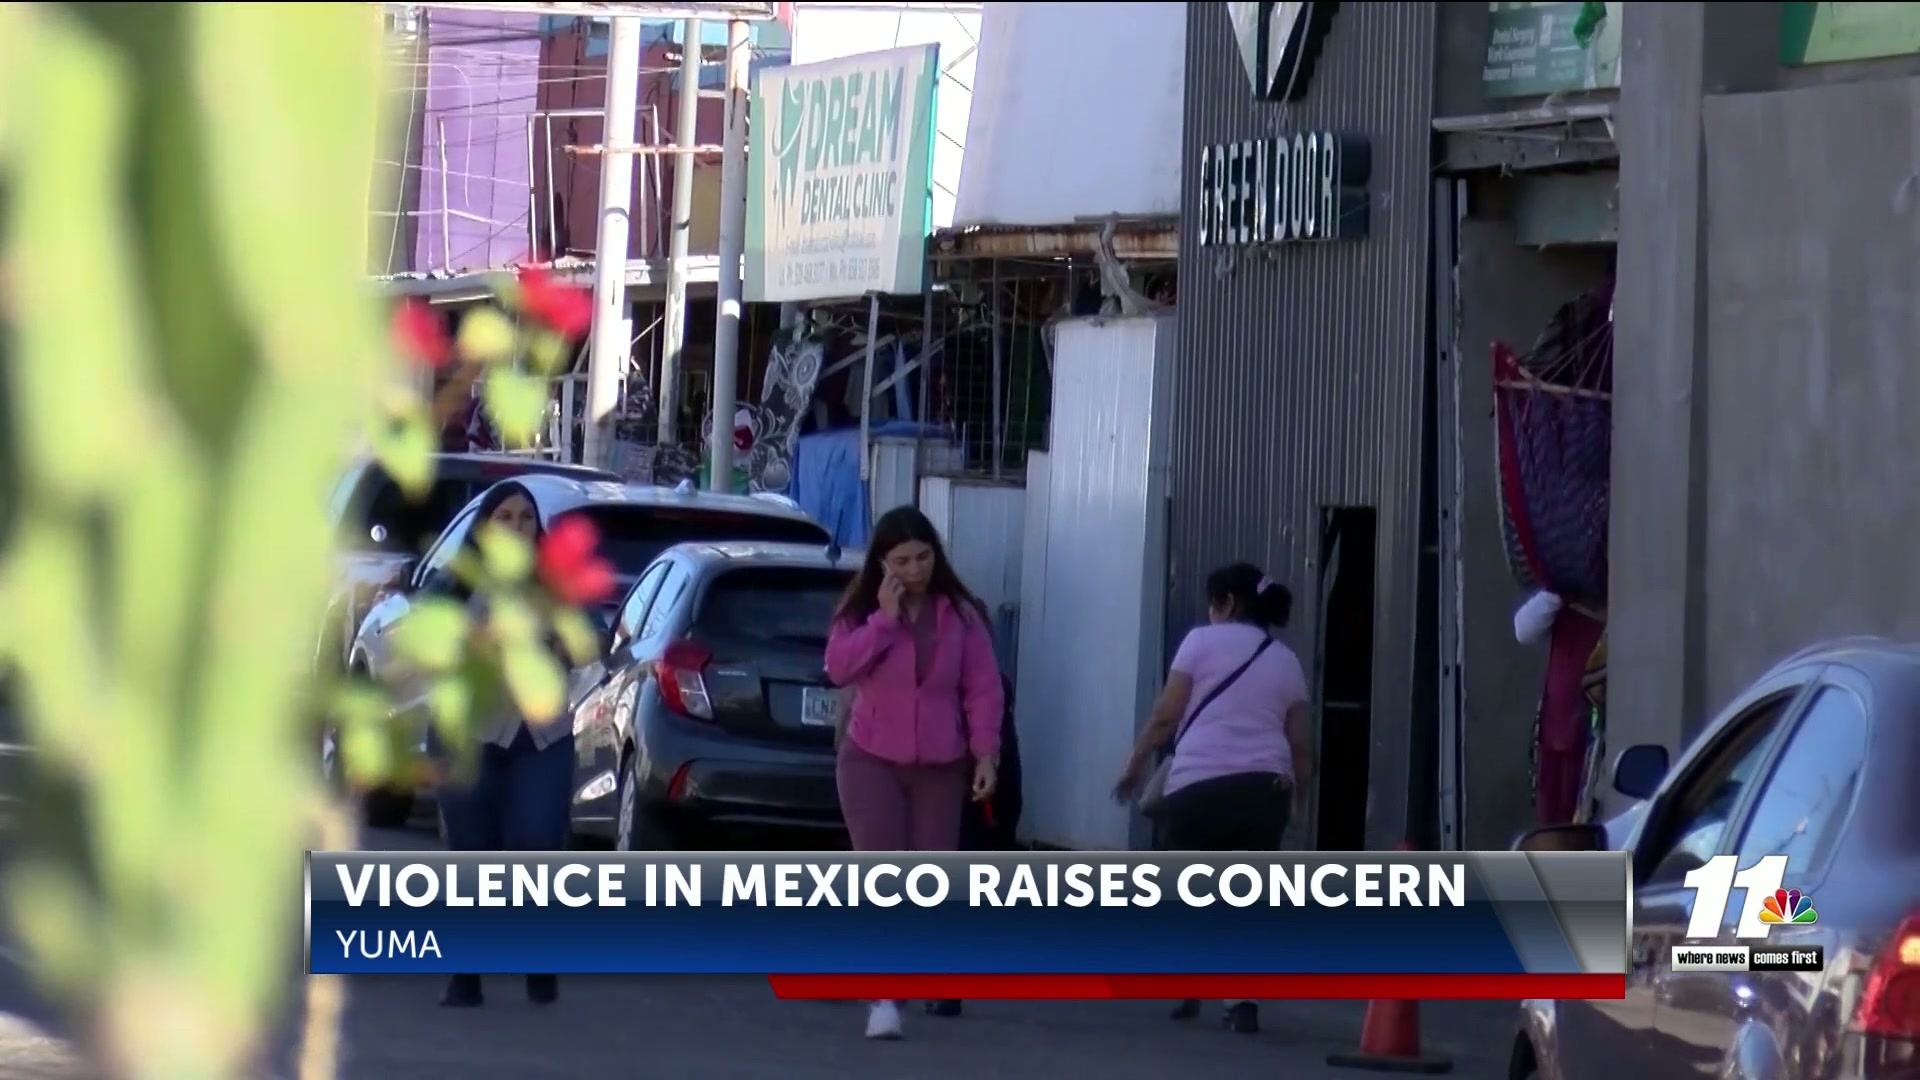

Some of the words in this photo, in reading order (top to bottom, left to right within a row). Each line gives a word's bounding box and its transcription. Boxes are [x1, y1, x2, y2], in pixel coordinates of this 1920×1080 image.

[804, 66, 904, 172] DREAM
[801, 172, 850, 225] DENTAL
[853, 169, 897, 219] CLINIC
[1201, 138, 1268, 247] GREEN
[1273, 131, 1334, 241] DOOR
